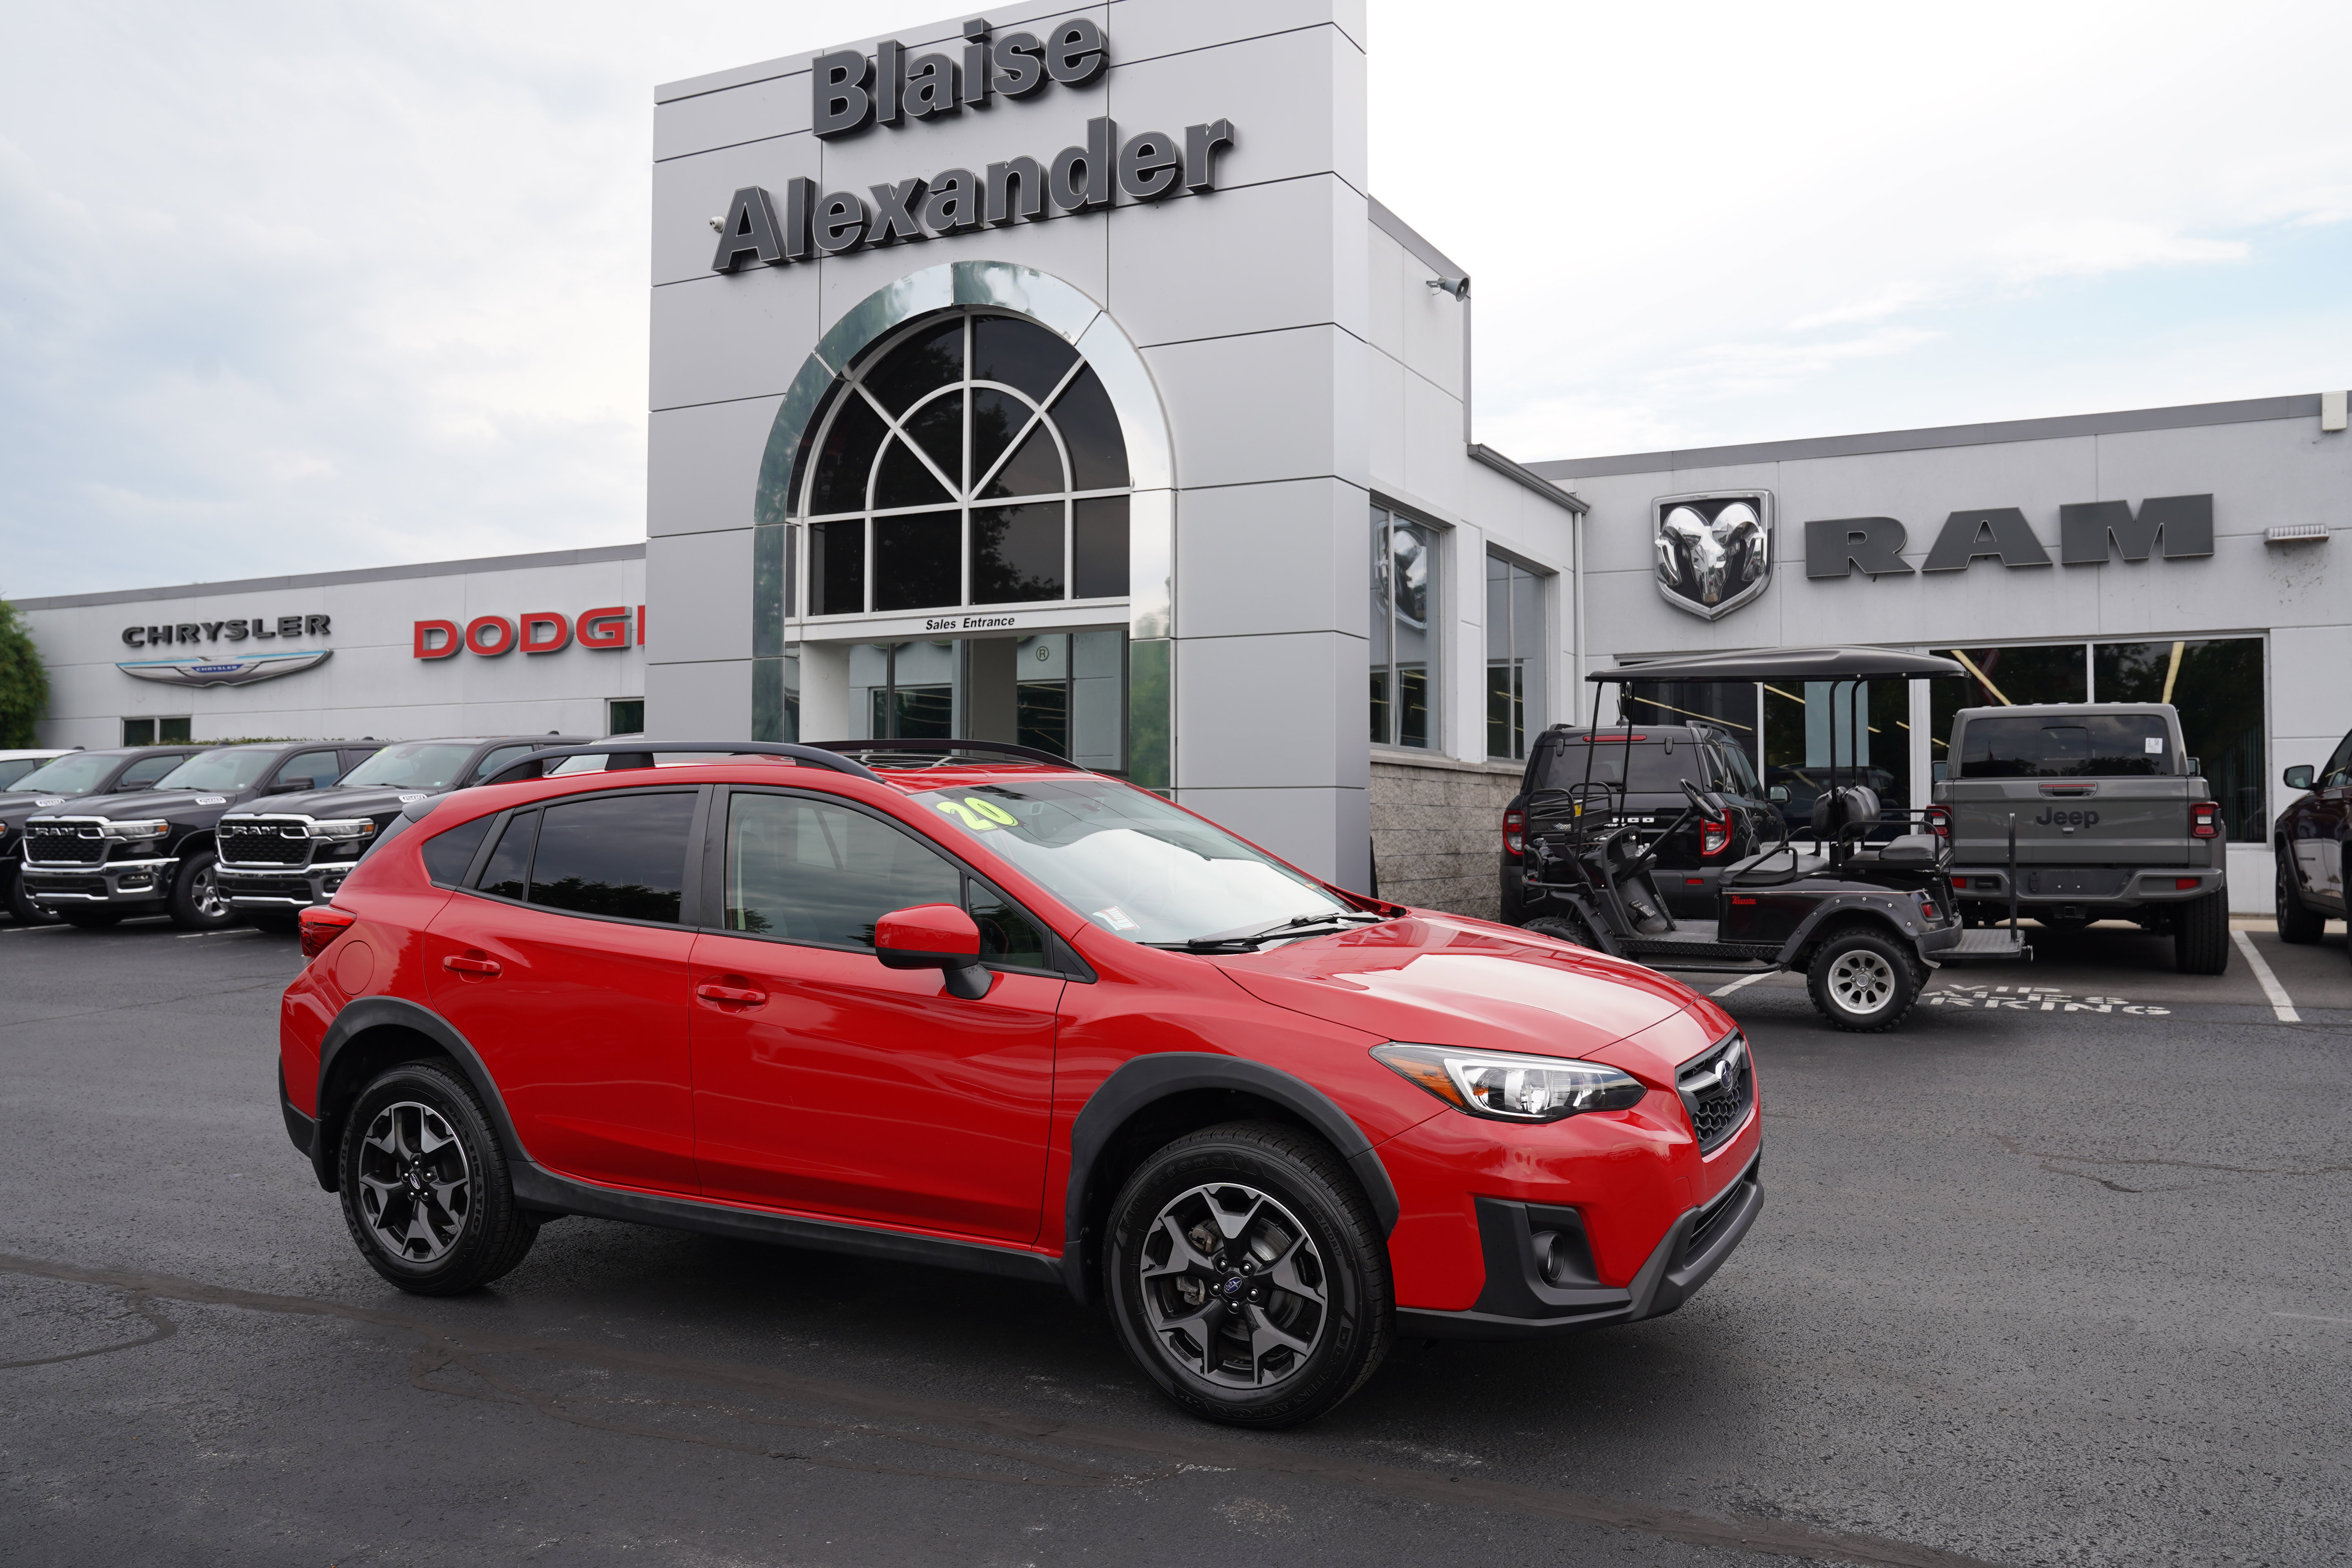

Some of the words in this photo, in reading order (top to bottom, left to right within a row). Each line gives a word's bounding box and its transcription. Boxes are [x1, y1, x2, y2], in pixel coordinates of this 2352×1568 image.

[812, 18, 1110, 140] Blaise
[711, 116, 1234, 274] Alexander
[1804, 493, 2215, 579] RAM
[122, 614, 331, 647] CHRYSLER
[413, 604, 645, 659] DODG
[926, 619, 956, 630] Sales
[963, 617, 1015, 628] Entrance
[936, 797, 1019, 831] 20
[2036, 806, 2100, 829] Jeep
[36, 827, 75, 836] RAM
[232, 826, 277, 835] RAM
[1921, 990, 2129, 1004] ALES
[1948, 984, 2061, 993] VIP
[1930, 997, 2171, 1015] RKING
